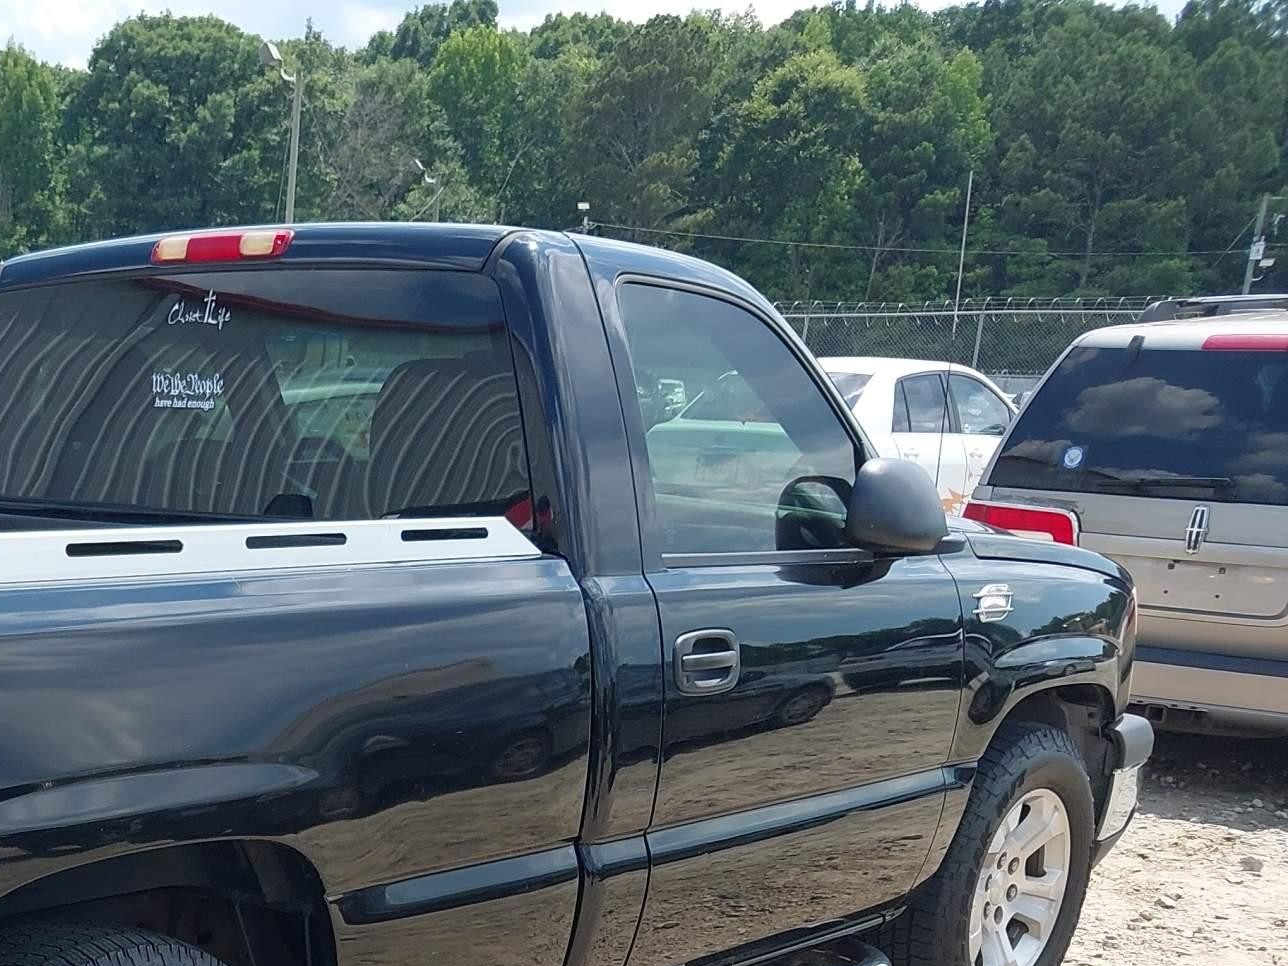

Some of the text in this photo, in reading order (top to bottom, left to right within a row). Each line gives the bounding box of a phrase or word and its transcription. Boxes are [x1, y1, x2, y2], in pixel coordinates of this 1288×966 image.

[152, 373, 170, 394] We
[183, 373, 225, 399] People
[154, 397, 215, 411] have had enough
